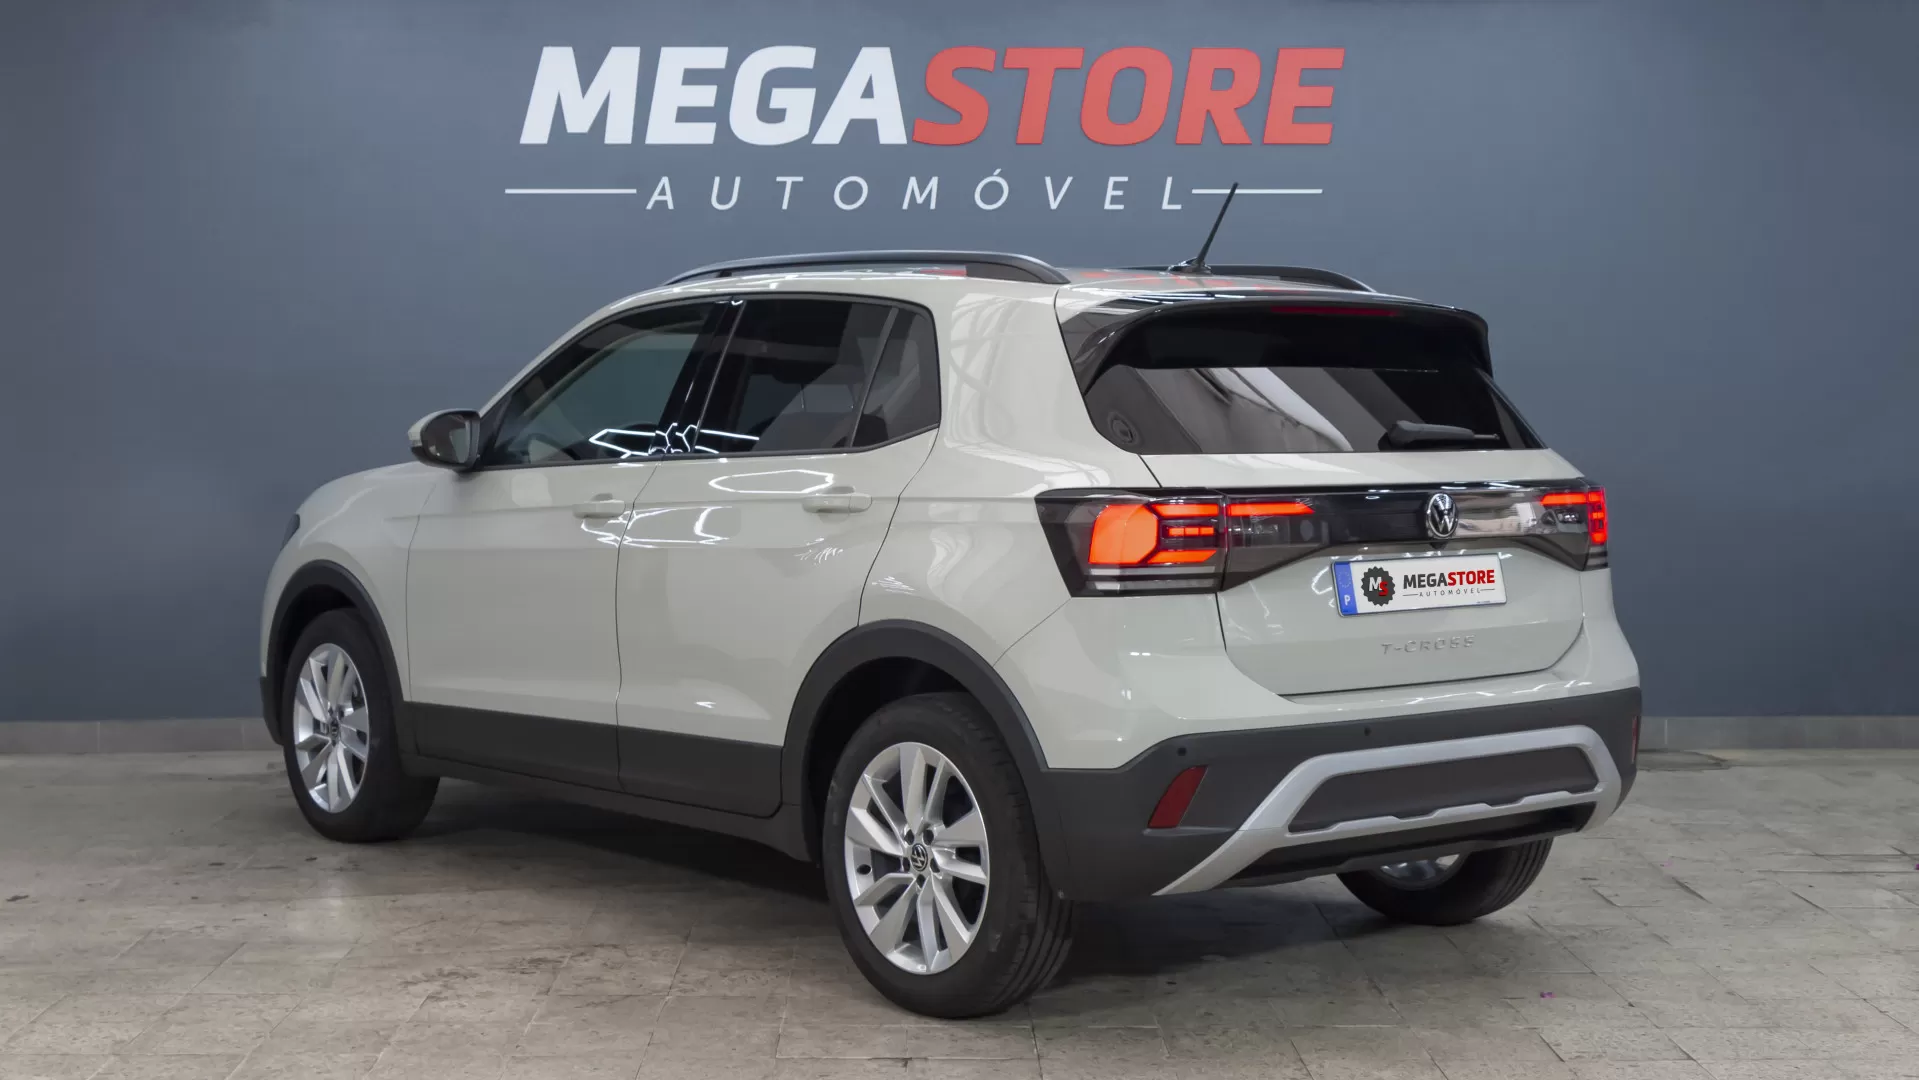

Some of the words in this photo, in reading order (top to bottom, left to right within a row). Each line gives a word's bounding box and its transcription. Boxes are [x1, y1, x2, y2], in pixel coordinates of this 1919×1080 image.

[519, 46, 1345, 145] MEGASTORE
[646, 168, 1184, 211] AUTOMÓVEL
[1403, 570, 1495, 589] MEGASTORE
[1344, 595, 1351, 605] P
[1419, 588, 1481, 597] AUTOMÓVEL
[1381, 636, 1475, 655] T-CROSS
